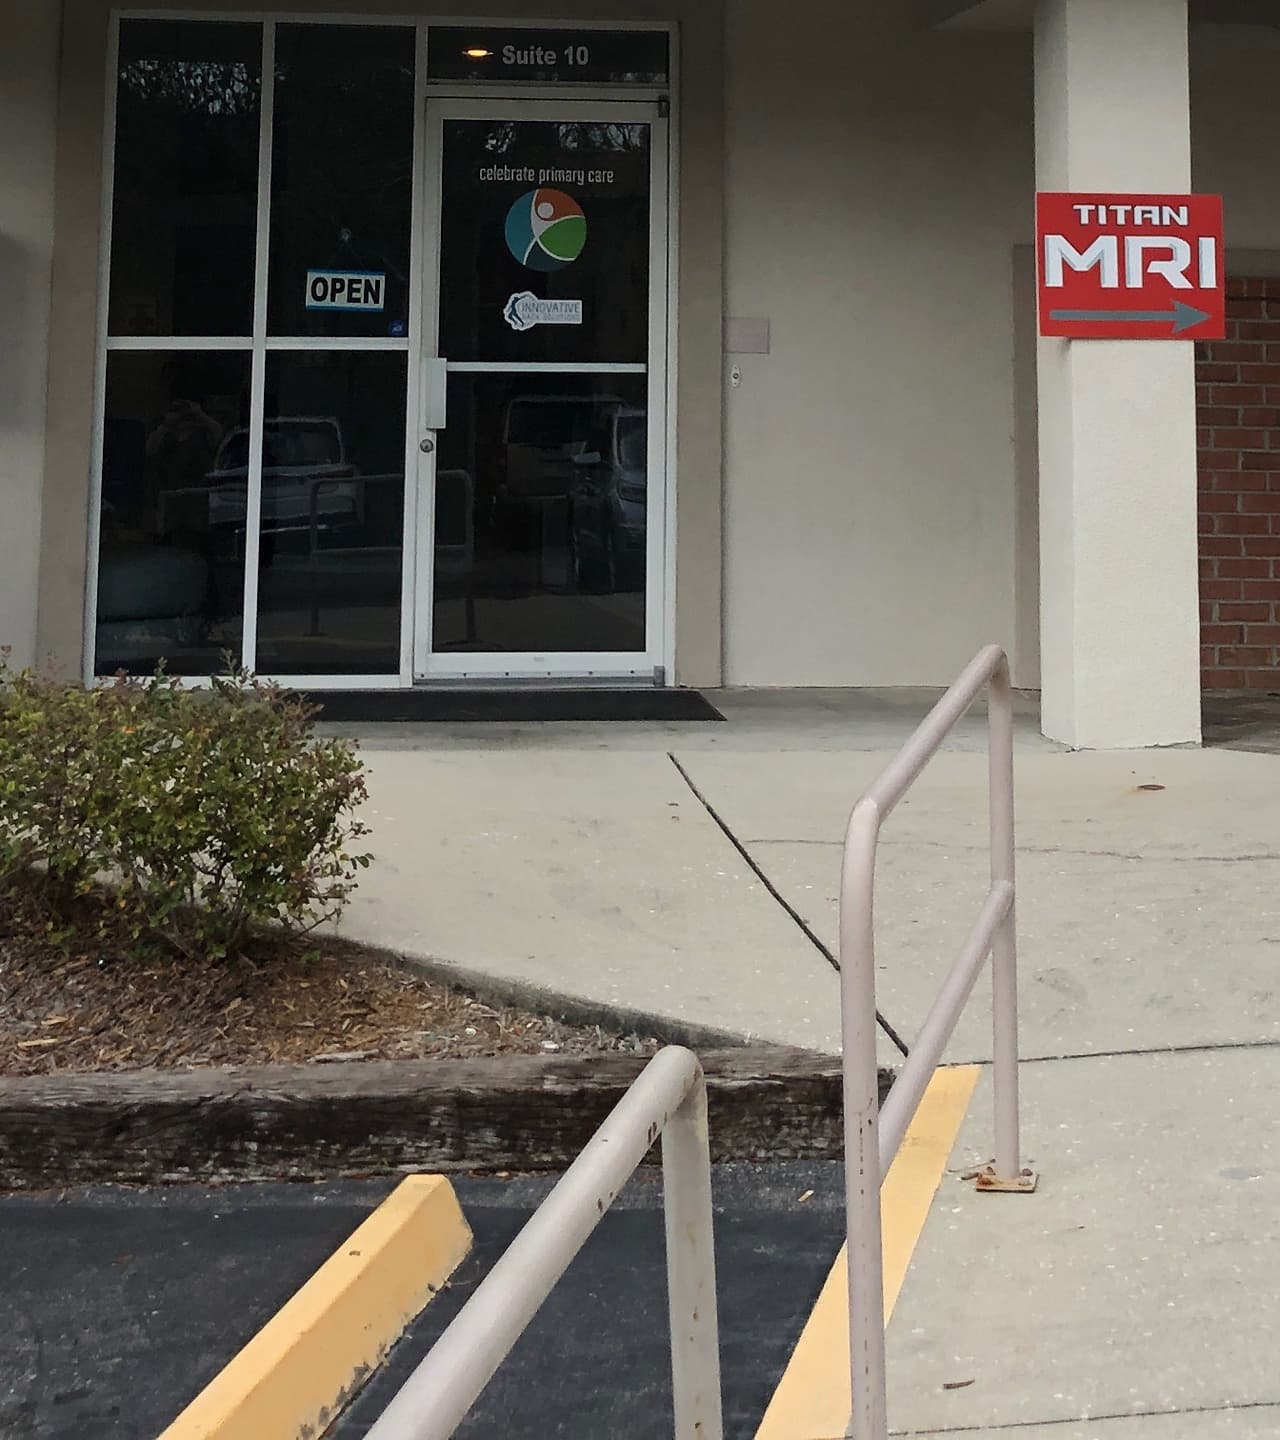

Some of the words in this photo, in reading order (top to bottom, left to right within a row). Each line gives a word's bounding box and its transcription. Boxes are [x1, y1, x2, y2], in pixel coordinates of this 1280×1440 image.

[502, 44, 557, 65] Suite
[564, 45, 589, 66] 10
[479, 164, 535, 182] celebrate
[538, 166, 585, 186] primary
[587, 169, 614, 183] care
[1072, 204, 1189, 227] TITAN
[1043, 234, 1218, 290] MRI
[310, 276, 381, 305] OPEN
[521, 302, 581, 313] INNOVATIVE
